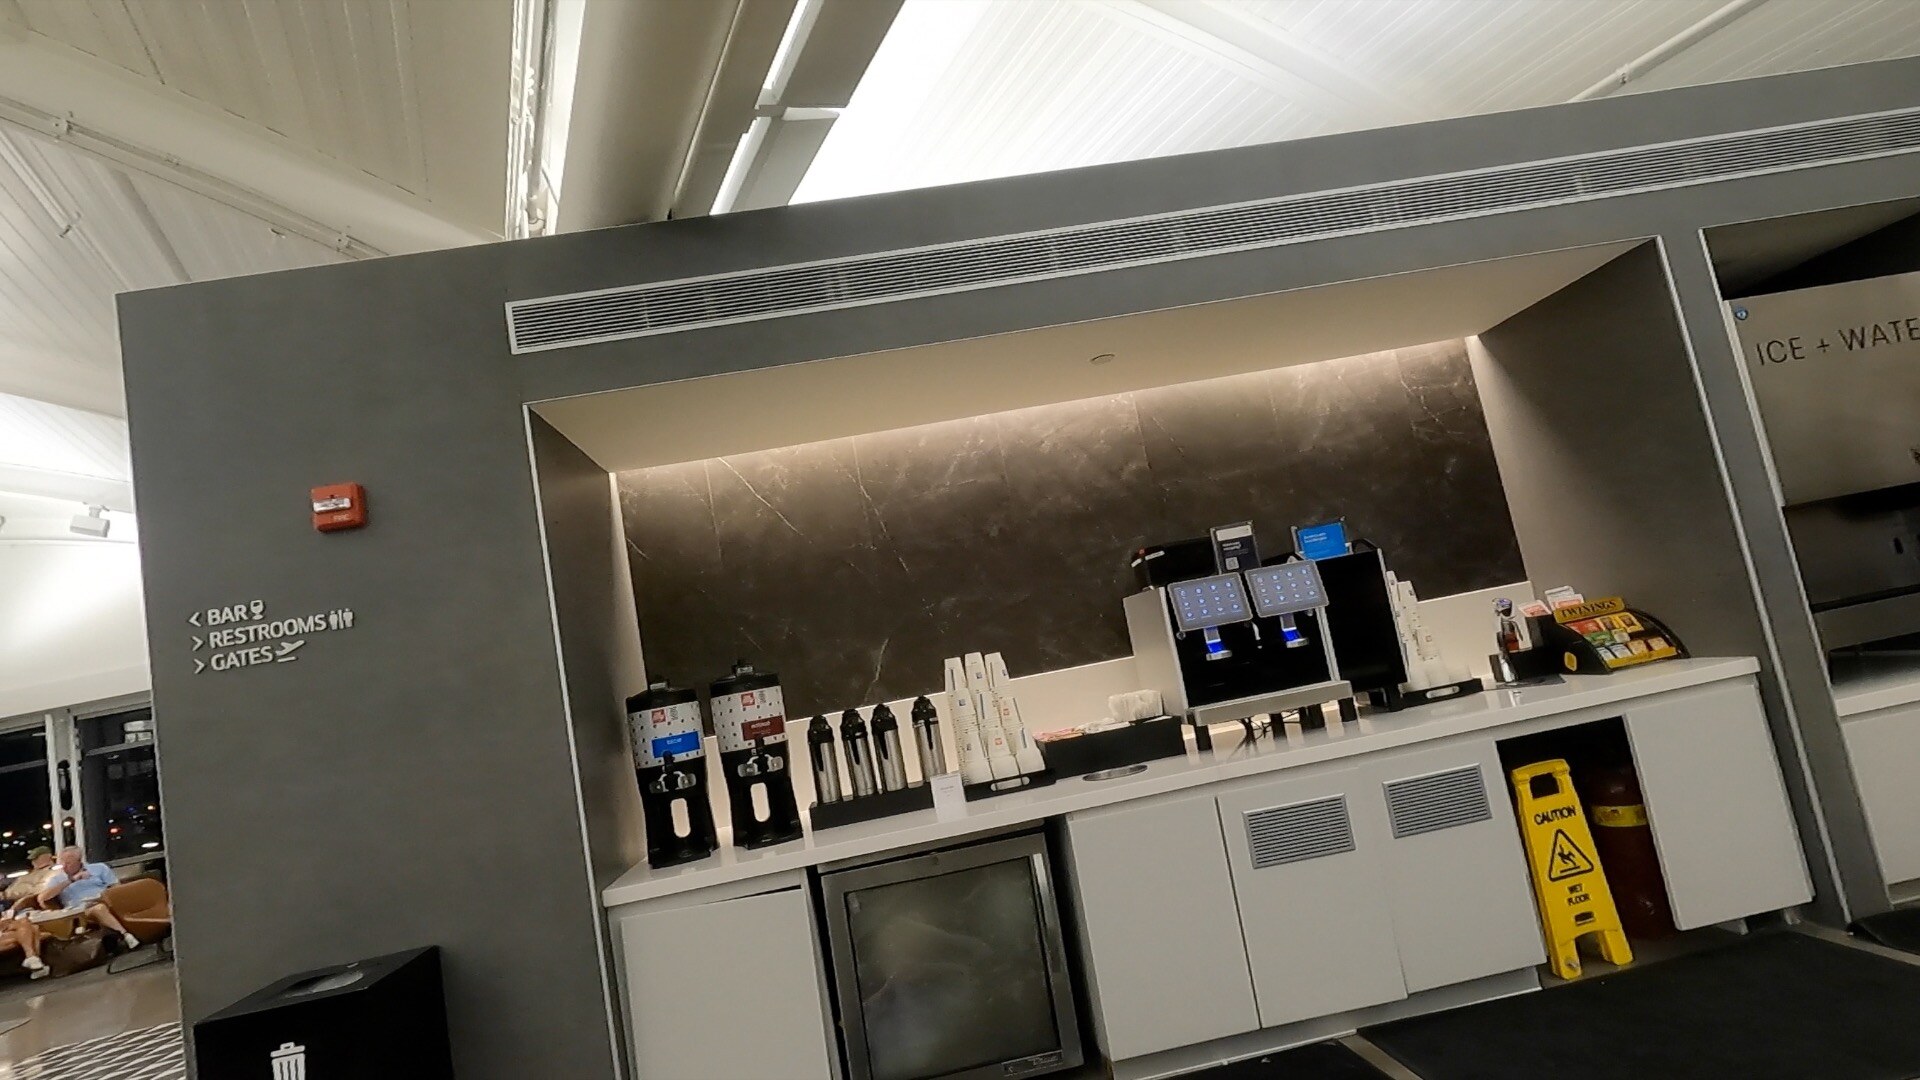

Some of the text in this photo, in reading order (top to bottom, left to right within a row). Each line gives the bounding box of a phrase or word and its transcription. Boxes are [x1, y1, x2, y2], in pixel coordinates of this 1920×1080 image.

[1757, 337, 1805, 366] ICE
[207, 604, 249, 626] BAR
[1562, 600, 1616, 617] TWININGS
[209, 614, 327, 649] RESTROOMS
[211, 646, 274, 671] GATES
[1535, 806, 1576, 825] CAUTION
[1567, 894, 1590, 906] FLOOR
